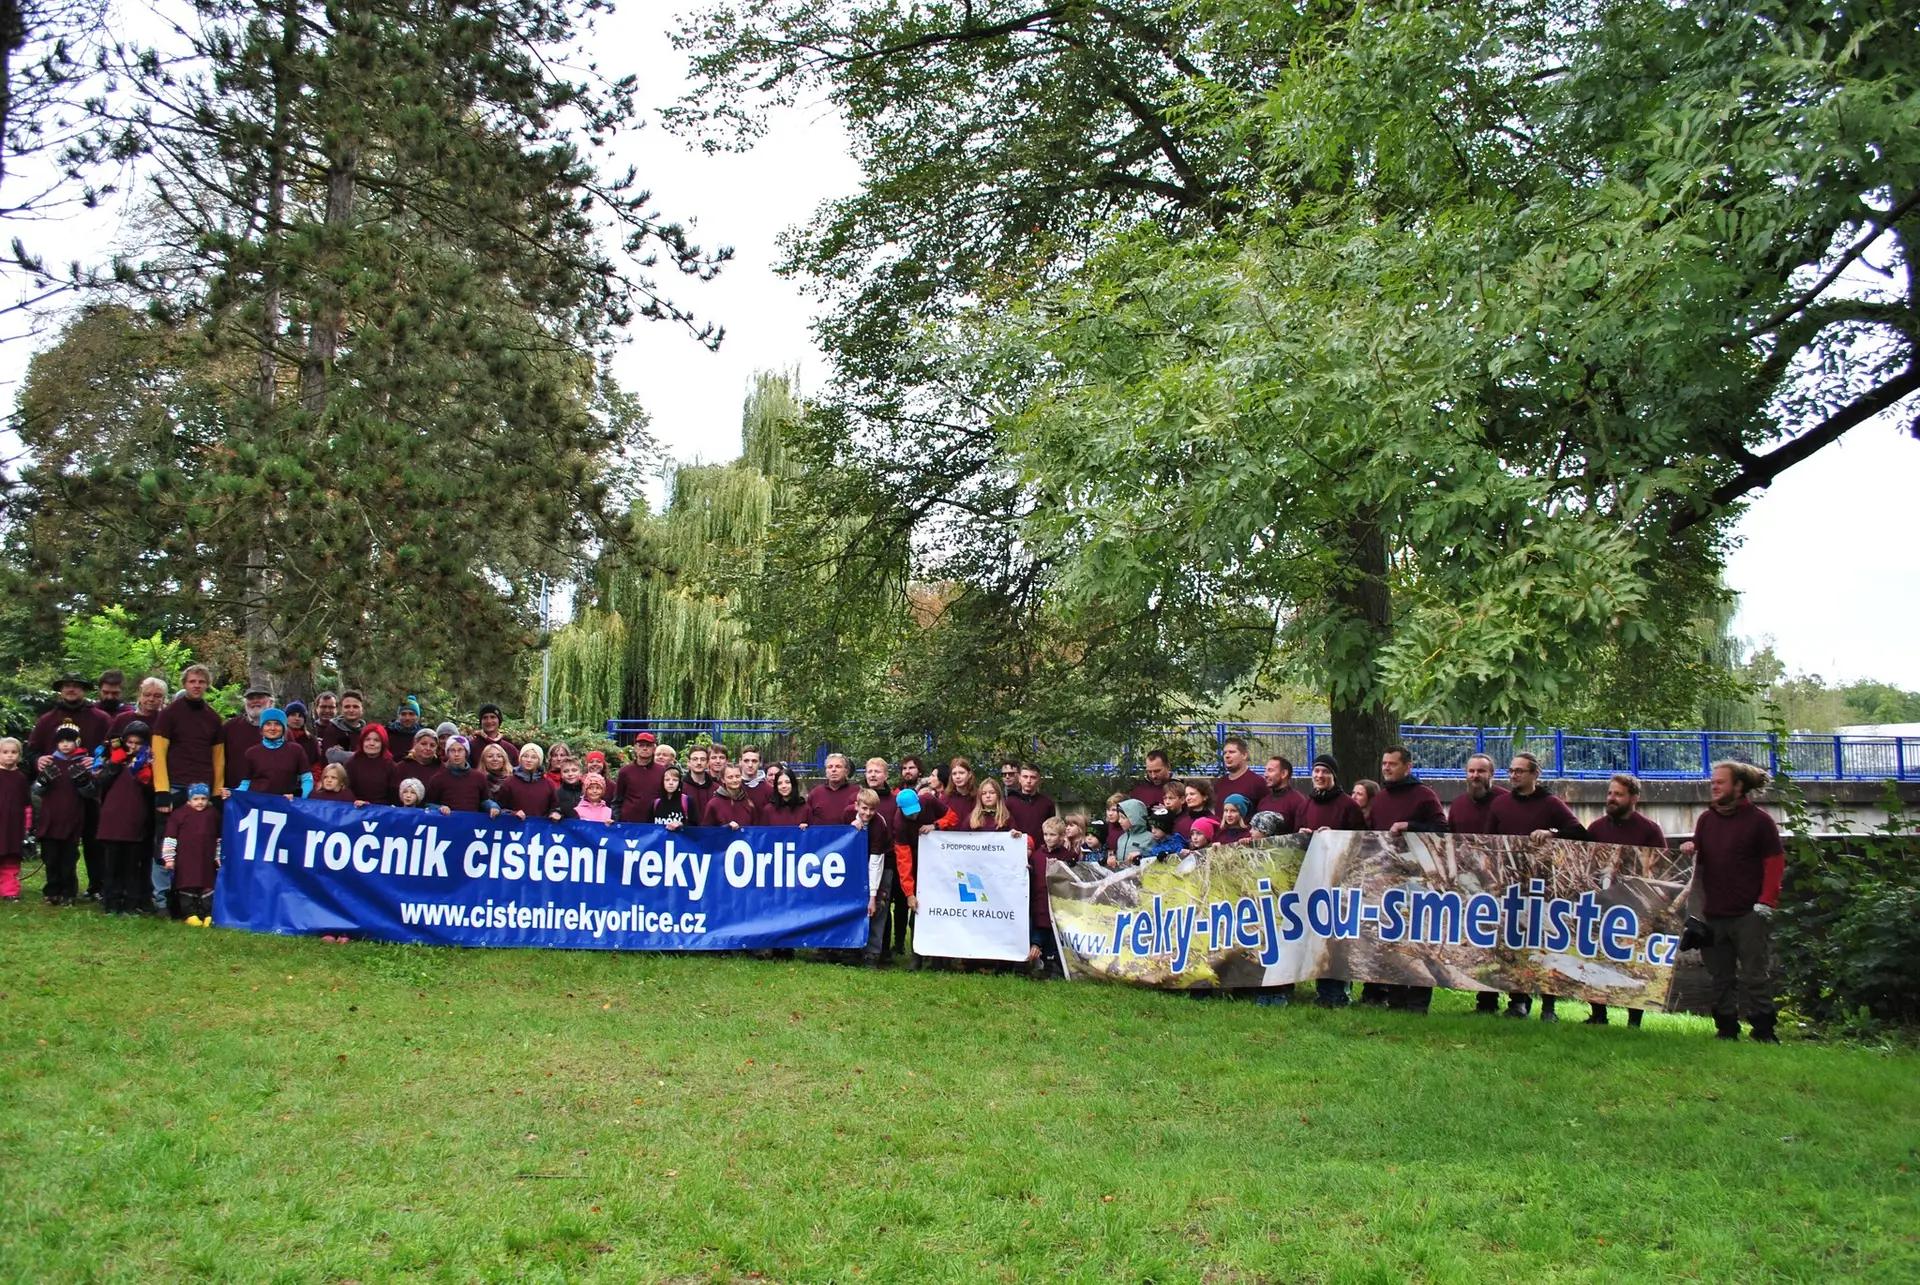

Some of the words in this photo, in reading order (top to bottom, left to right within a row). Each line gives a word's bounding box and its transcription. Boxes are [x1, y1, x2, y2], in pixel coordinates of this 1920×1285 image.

[238, 808, 289, 864] 17.
[303, 821, 451, 878] ročník
[463, 829, 609, 885] čištění
[621, 839, 711, 900] řeky
[724, 839, 846, 888] Orlice
[946, 843, 981, 851] PODPOROU
[982, 843, 1005, 852] MĚSTA
[400, 899, 707, 938] www.cistenirekyorlice.cz
[928, 907, 968, 918] HRADEC
[972, 908, 1015, 920] KRÁLOVÉ
